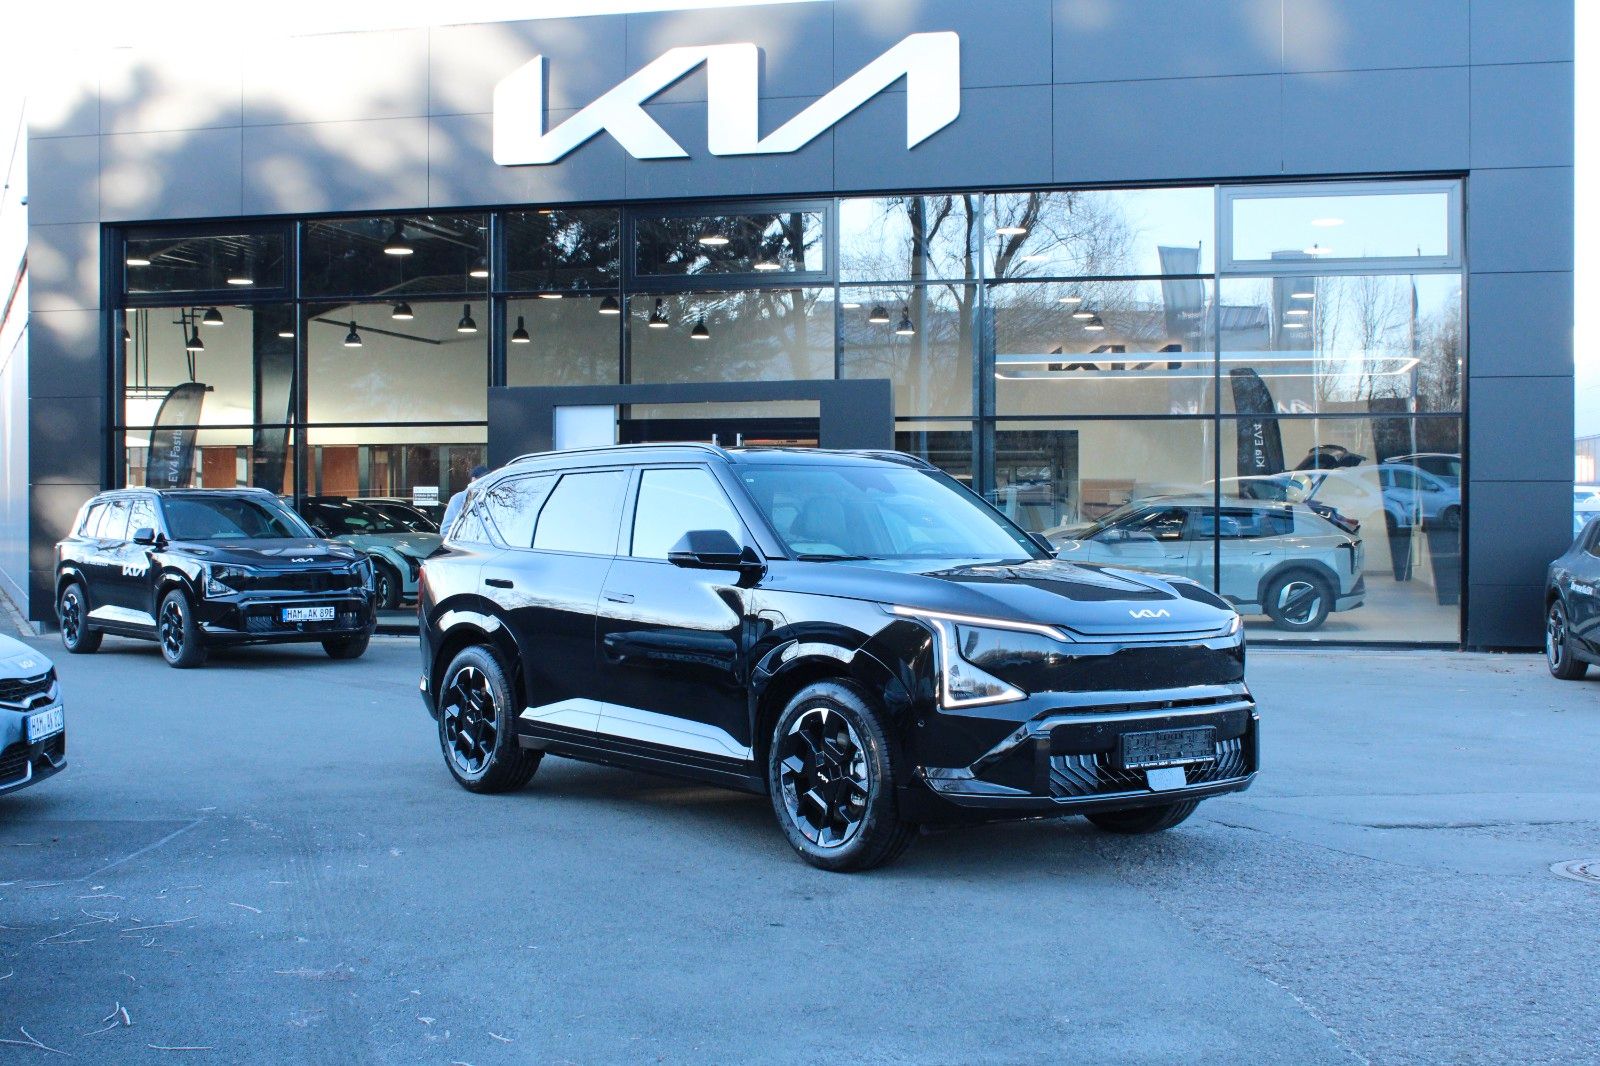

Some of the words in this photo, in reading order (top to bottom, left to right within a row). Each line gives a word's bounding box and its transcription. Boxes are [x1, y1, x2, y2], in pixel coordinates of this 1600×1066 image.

[493, 31, 960, 166] KIA
[168, 460, 180, 482] EV4
[287, 609, 303, 619] HAM
[308, 609, 318, 618] AK
[319, 608, 334, 618] 89E
